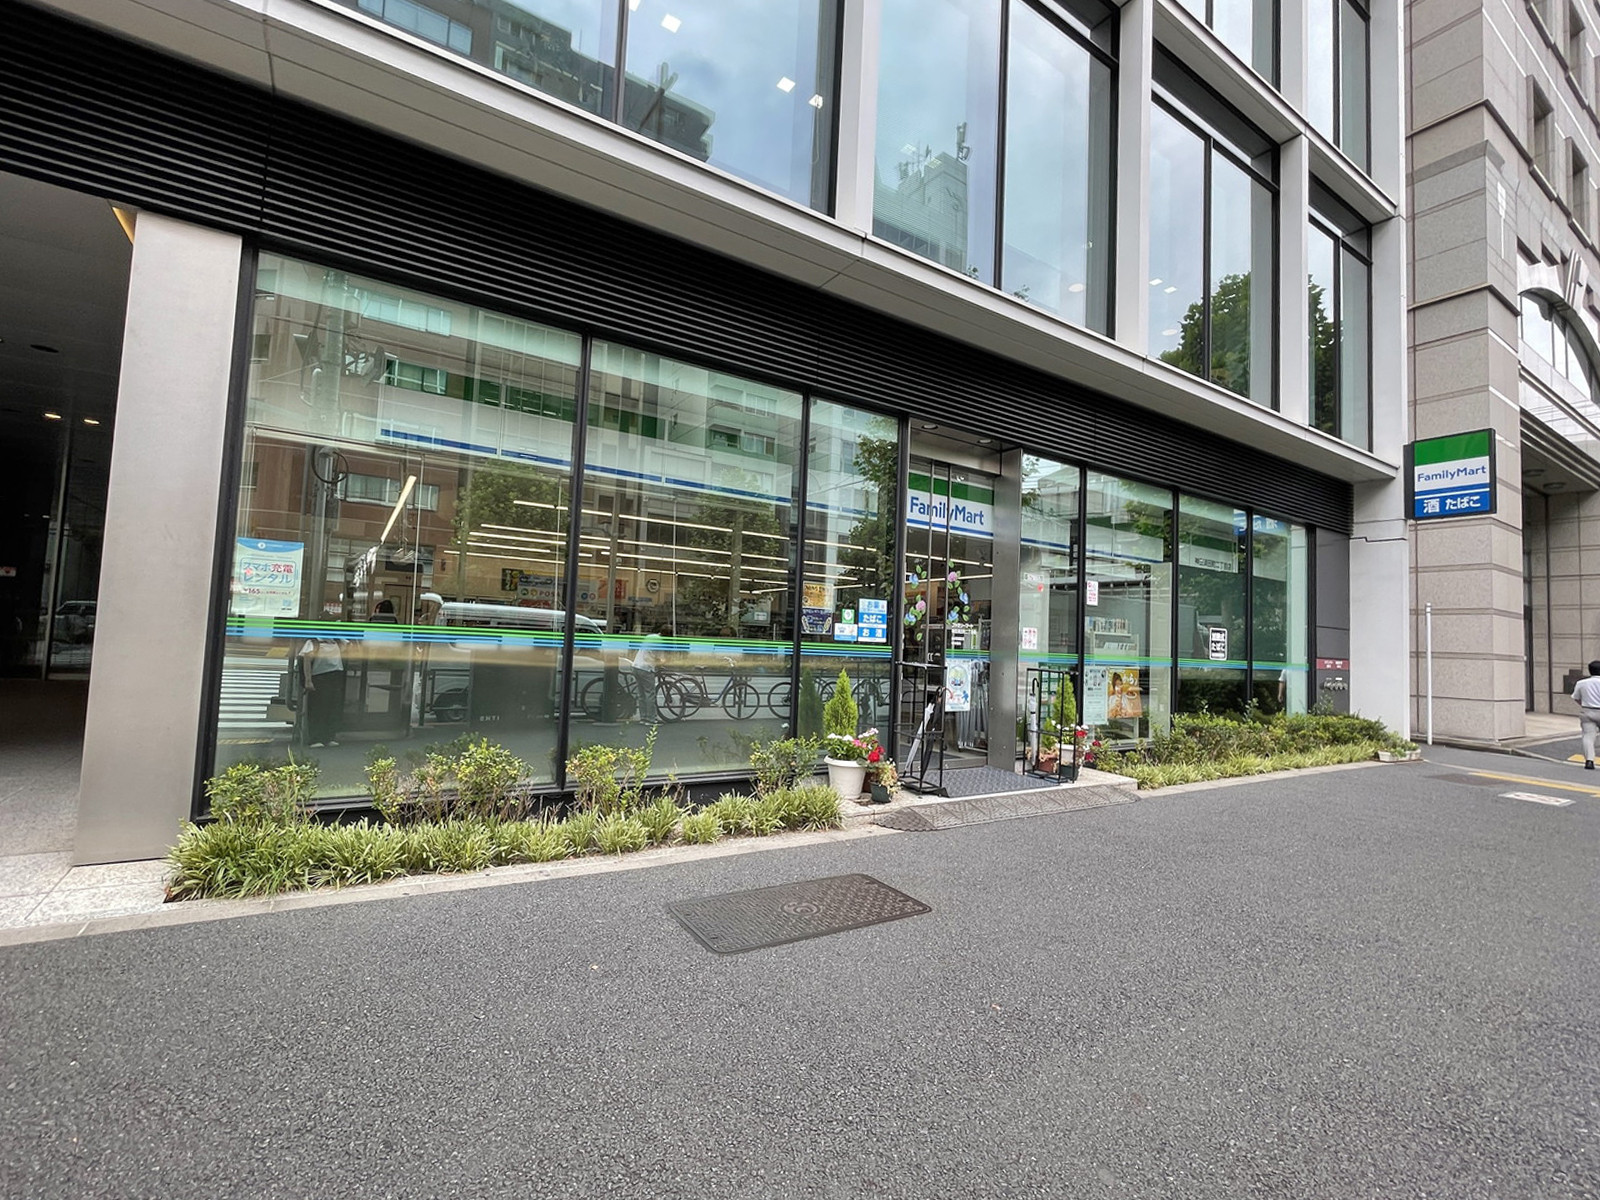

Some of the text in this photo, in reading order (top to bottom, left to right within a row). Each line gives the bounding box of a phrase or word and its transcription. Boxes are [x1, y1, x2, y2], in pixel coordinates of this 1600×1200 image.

[1417, 465, 1487, 482] FamilyMart
[910, 496, 984, 526] FamilyMart
[1423, 495, 1481, 514] 酒 たばこ
[243, 563, 293, 574] スマホ充電
[243, 573, 292, 584] レンタル
[863, 614, 883, 624] たばこ
